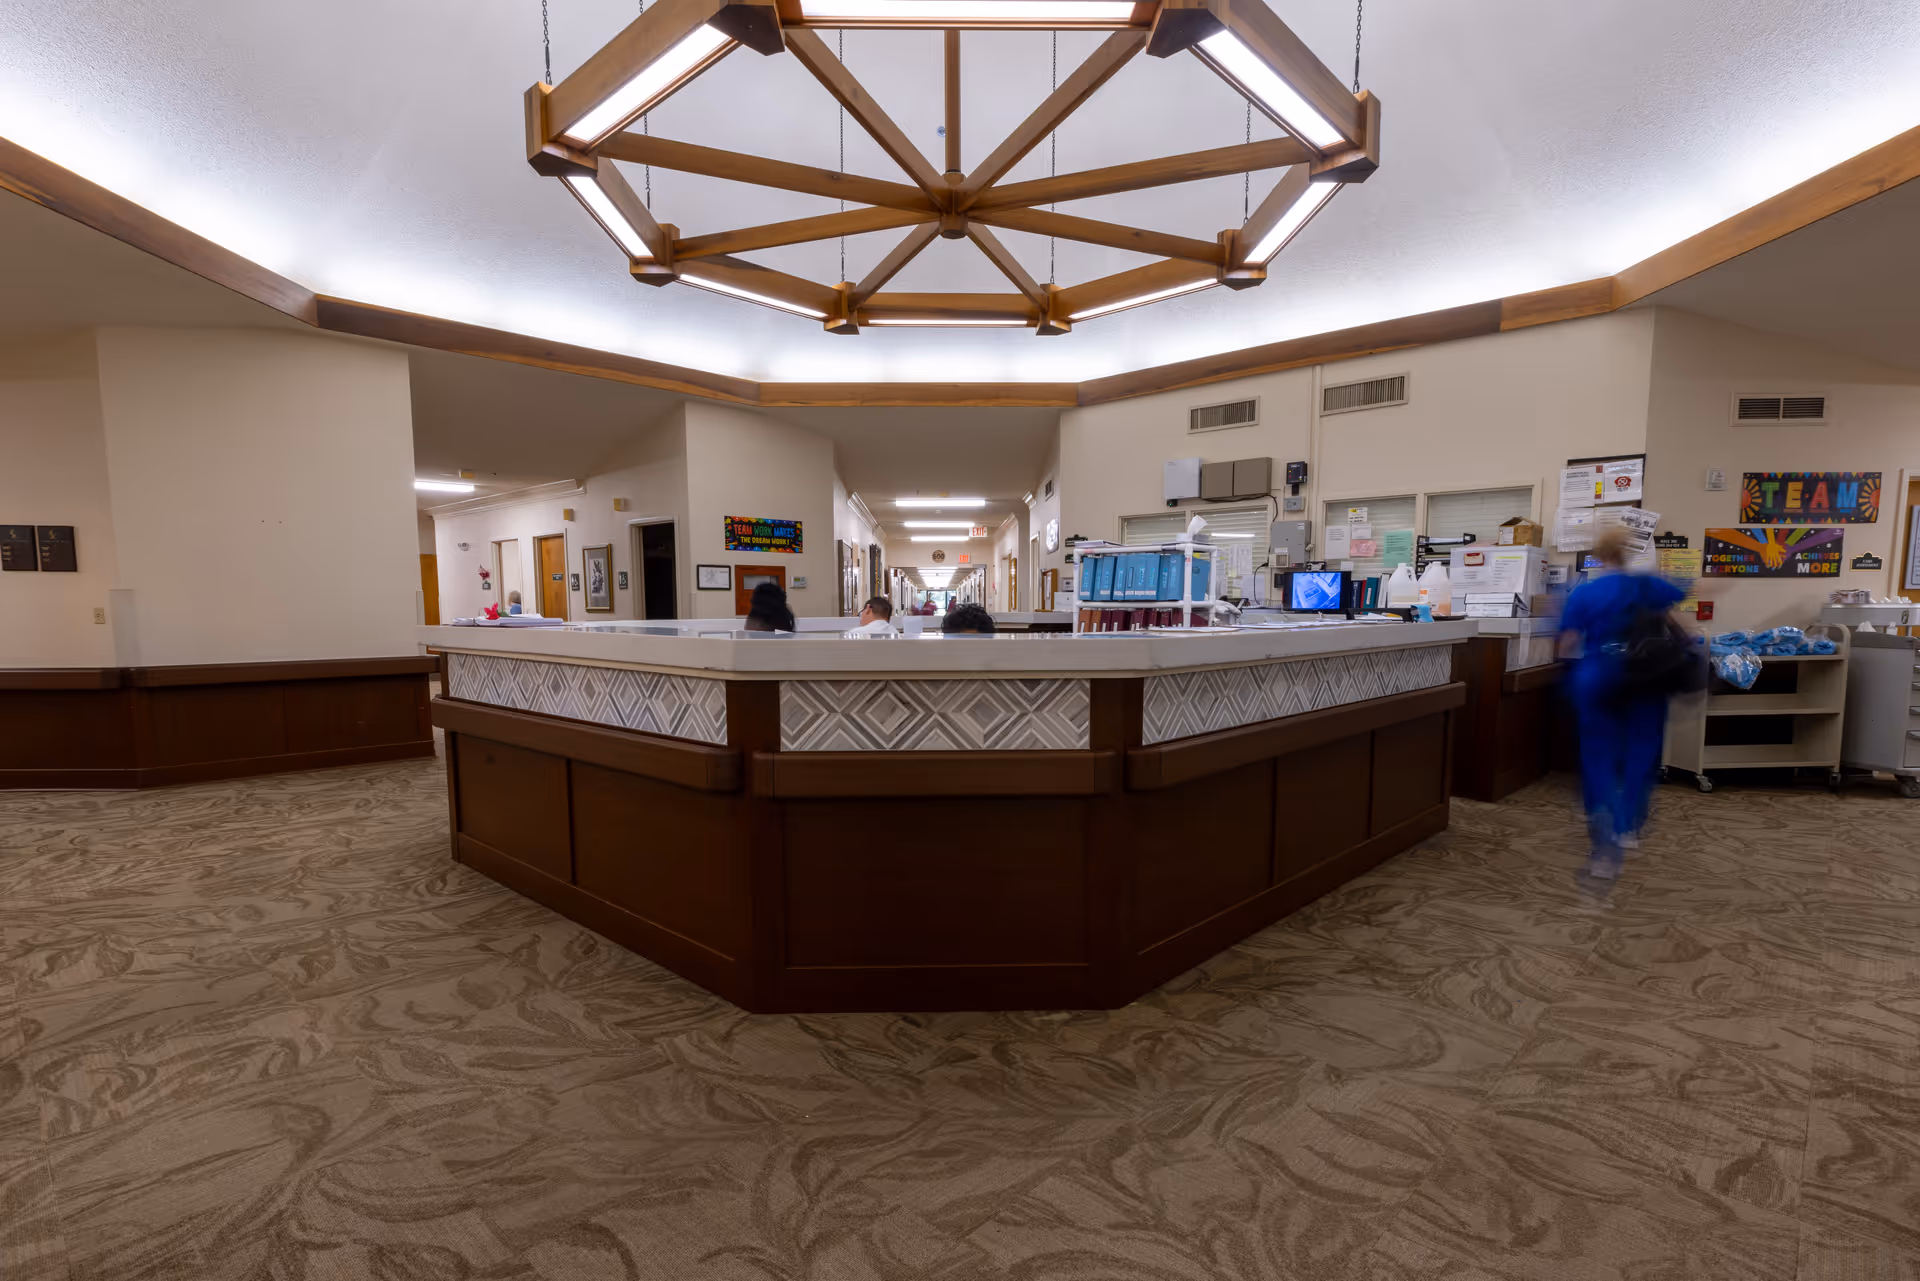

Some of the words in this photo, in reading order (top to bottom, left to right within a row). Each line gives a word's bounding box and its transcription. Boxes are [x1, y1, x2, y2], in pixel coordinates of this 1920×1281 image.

[1761, 481, 1859, 509] TEAM
[733, 524, 753, 535] TEAM
[753, 526, 773, 537] WORK
[773, 527, 795, 538] MAKES
[972, 527, 985, 537] EXIT
[740, 536, 751, 544] THE
[751, 537, 771, 545] DREAM
[959, 554, 969, 563] EXIT
[1706, 554, 1755, 562] TOGETHER
[1795, 552, 1840, 561] ACHIEVES
[1705, 564, 1759, 573] EVERYONE
[1797, 562, 1838, 574] MORE
